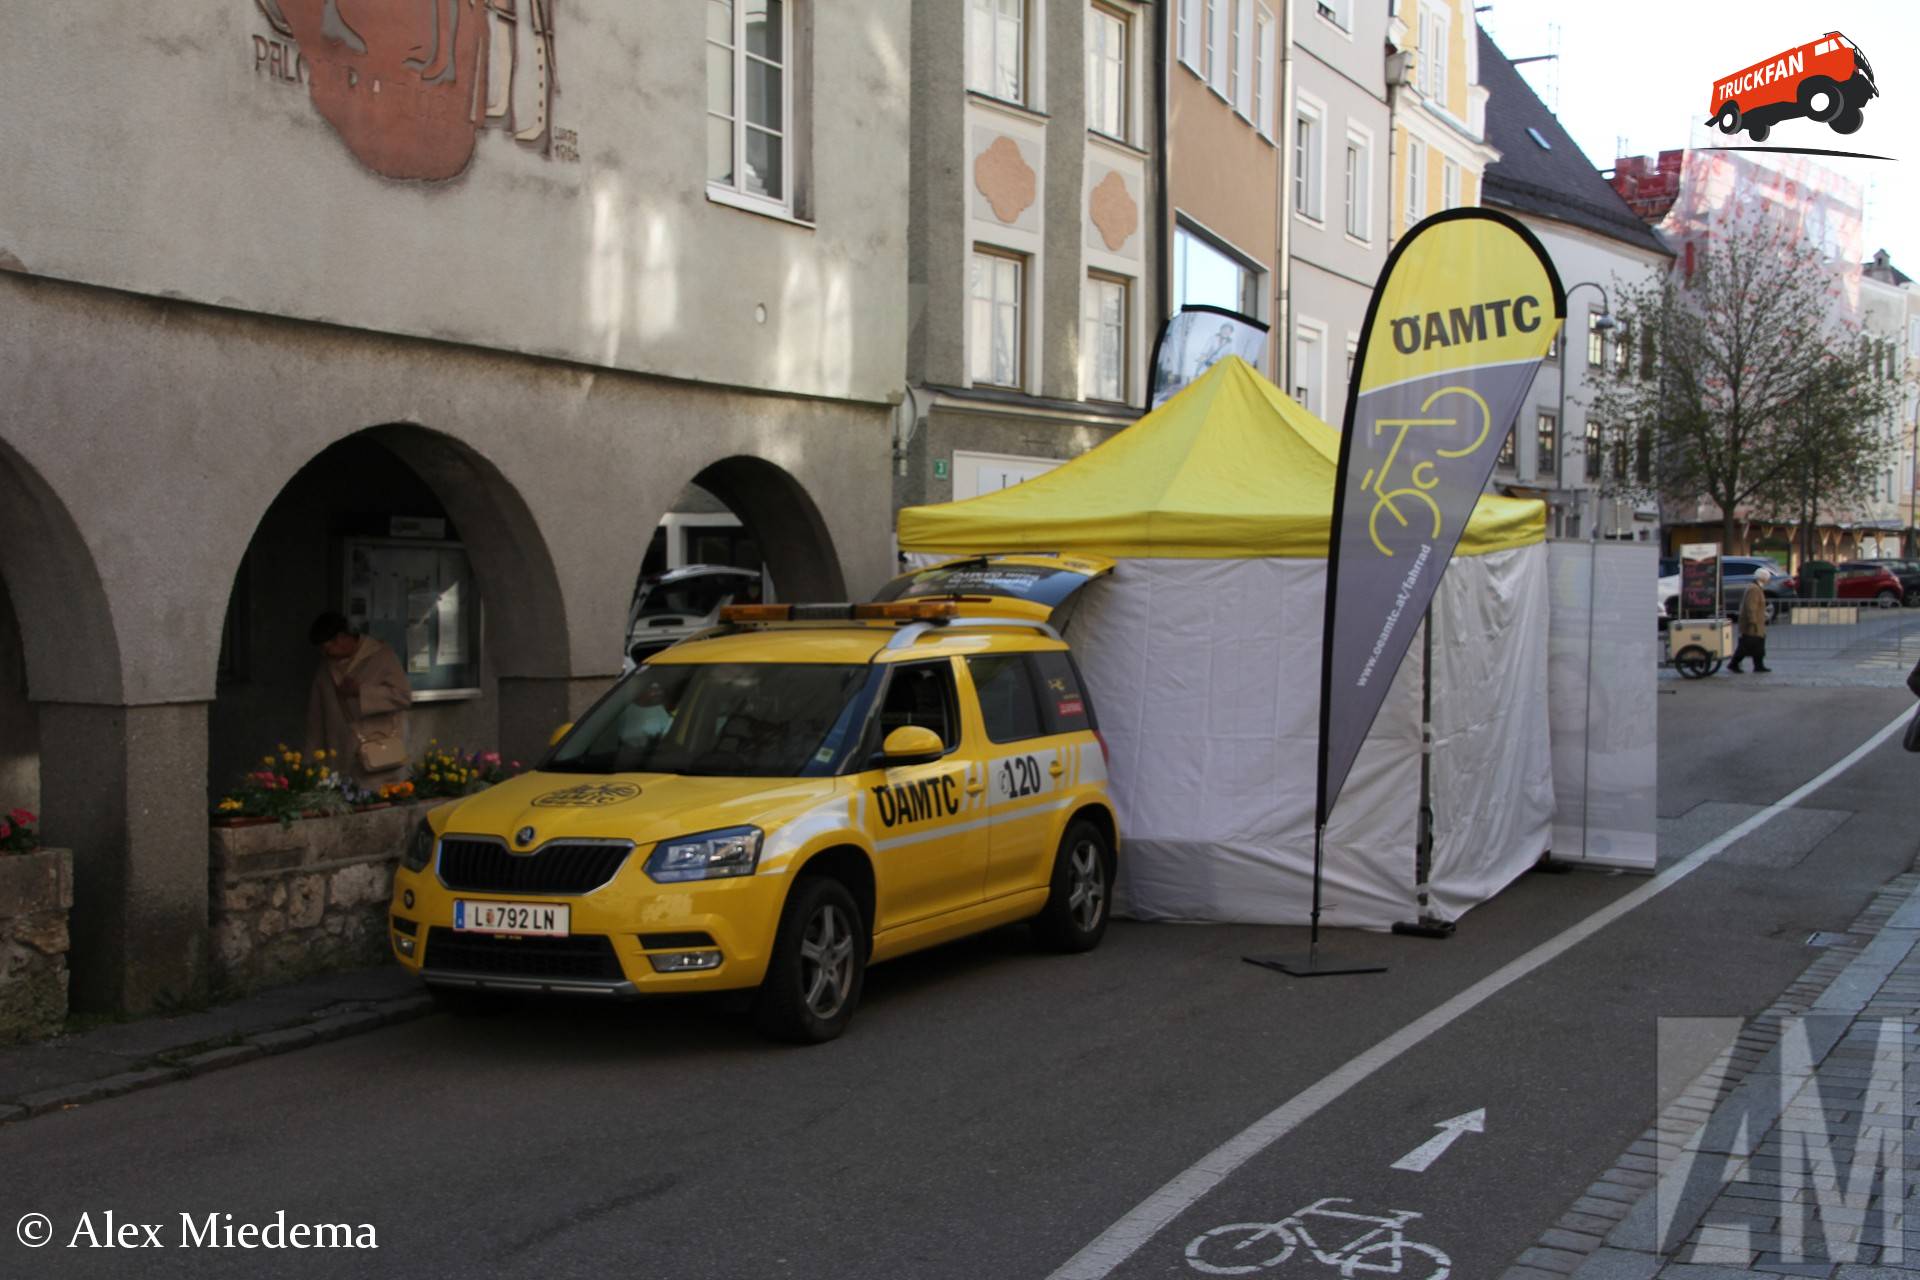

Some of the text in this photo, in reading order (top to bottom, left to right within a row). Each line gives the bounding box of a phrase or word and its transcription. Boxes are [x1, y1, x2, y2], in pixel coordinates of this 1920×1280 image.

[1390, 294, 1542, 355] ÖAMTC
[1356, 543, 1432, 687] www.oeamtc.at/fahrrad
[871, 773, 959, 828] ÖAMTC
[1003, 755, 1041, 799] 120
[474, 906, 554, 930] L 792 LN
